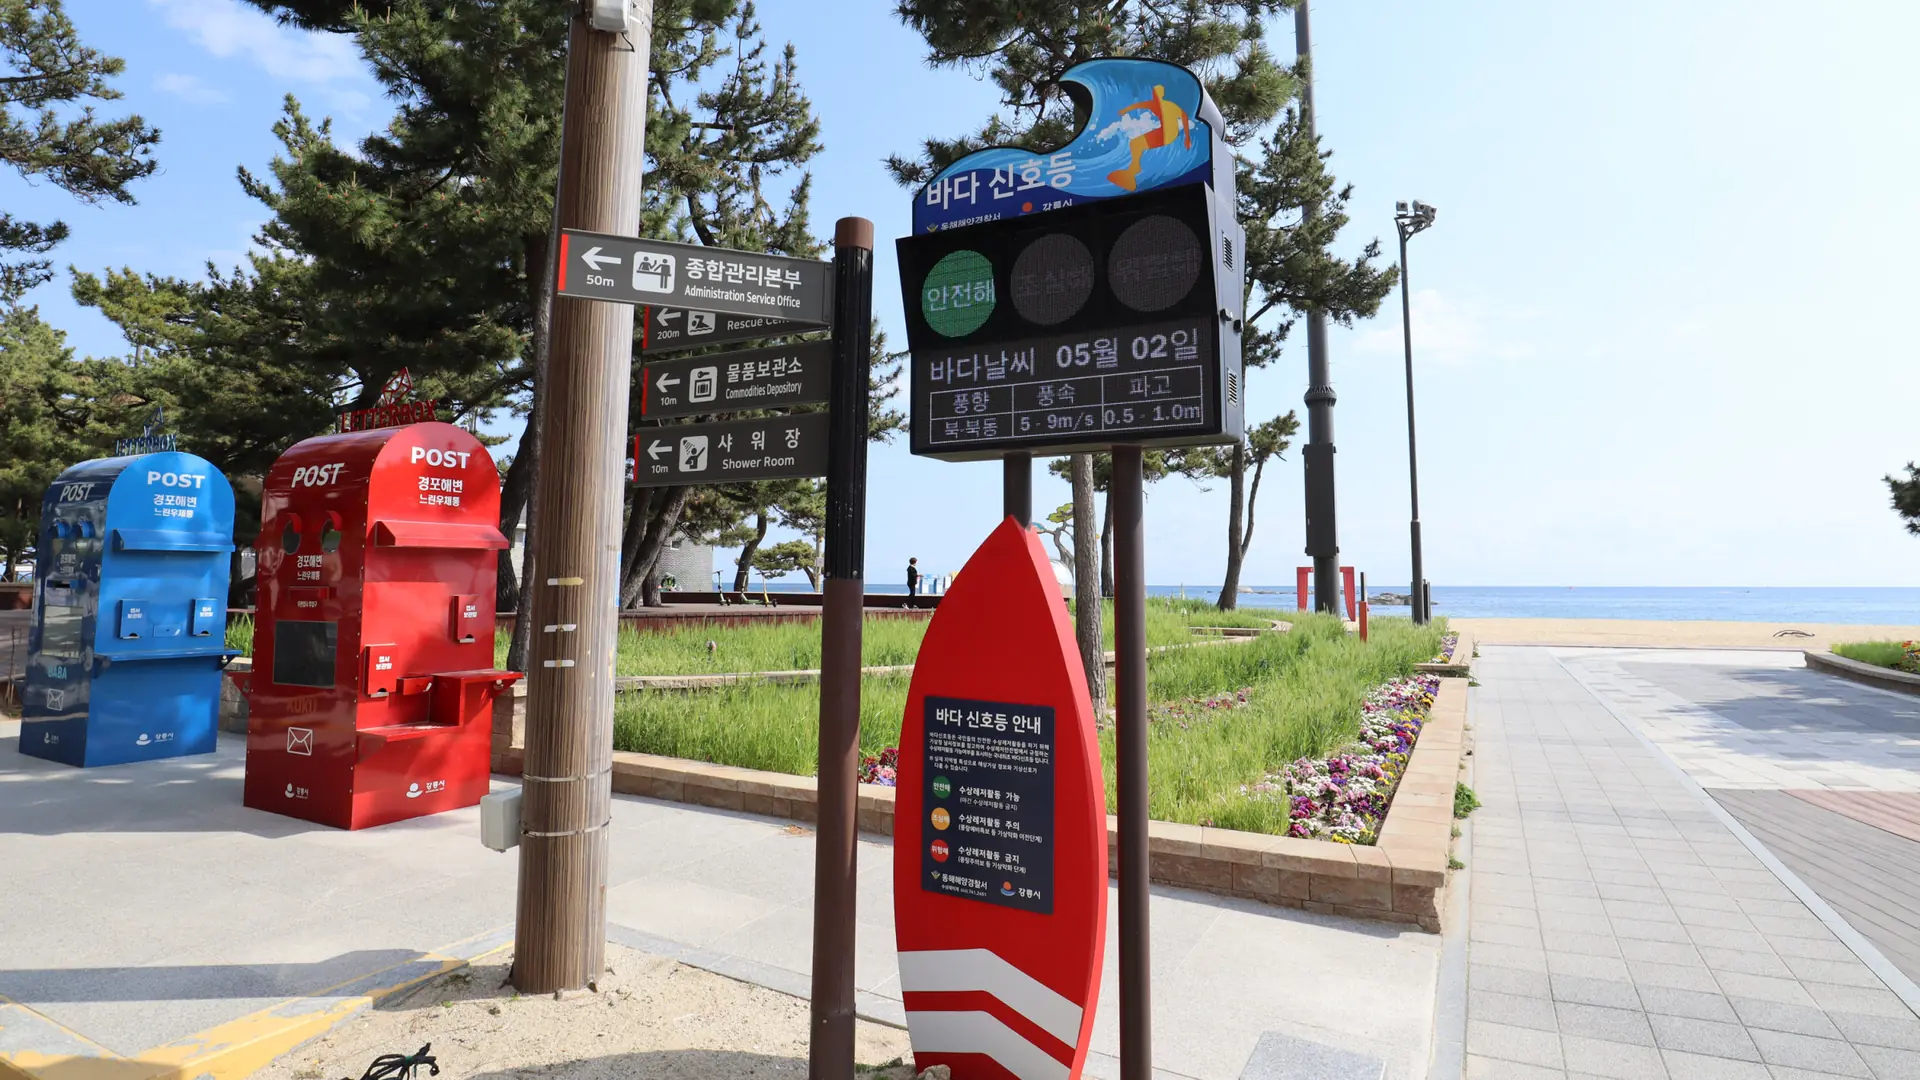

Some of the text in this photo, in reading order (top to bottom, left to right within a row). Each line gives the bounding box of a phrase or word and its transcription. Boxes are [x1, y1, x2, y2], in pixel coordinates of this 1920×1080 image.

[926, 151, 1076, 210] 바다 신호등
[586, 274, 615, 288] 50m
[684, 257, 802, 290] 종합관리본부
[684, 284, 801, 309] Administration Service Office
[927, 278, 996, 312] 안전해
[727, 316, 763, 332] Rescue
[657, 329, 680, 340] 200m
[930, 327, 1199, 384] 바다날씨 05월 02일
[726, 356, 803, 383] 물품보관소
[725, 381, 802, 400] Commodities Depository
[953, 375, 1173, 414] 풍향 풍속 파고
[660, 397, 677, 406] 10m
[341, 399, 438, 433] LETTERBOX
[1047, 412, 1094, 431] 9m/s
[1153, 404, 1201, 421] 1.0m
[411, 446, 471, 470] POST
[722, 455, 795, 470] Shower Room
[291, 462, 345, 488] POST
[651, 464, 669, 474] 10m
[147, 471, 206, 489] POST
[418, 476, 464, 494] 경포해변
[59, 483, 95, 502] POST
[153, 493, 197, 508] 경포해변
[419, 494, 461, 507] 느린우체통
[154, 507, 194, 519] 느린우체통
[296, 555, 323, 569] 경포해변
[47, 666, 67, 680] BABA
[936, 708, 1041, 735] 바다 신호등 안내
[959, 785, 1021, 802] 수상레저활동 가능
[958, 813, 1020, 831] 수상레저활동 주의
[958, 846, 1020, 864] 수상레저활동 금지
[1018, 887, 1041, 899] 강릉시
